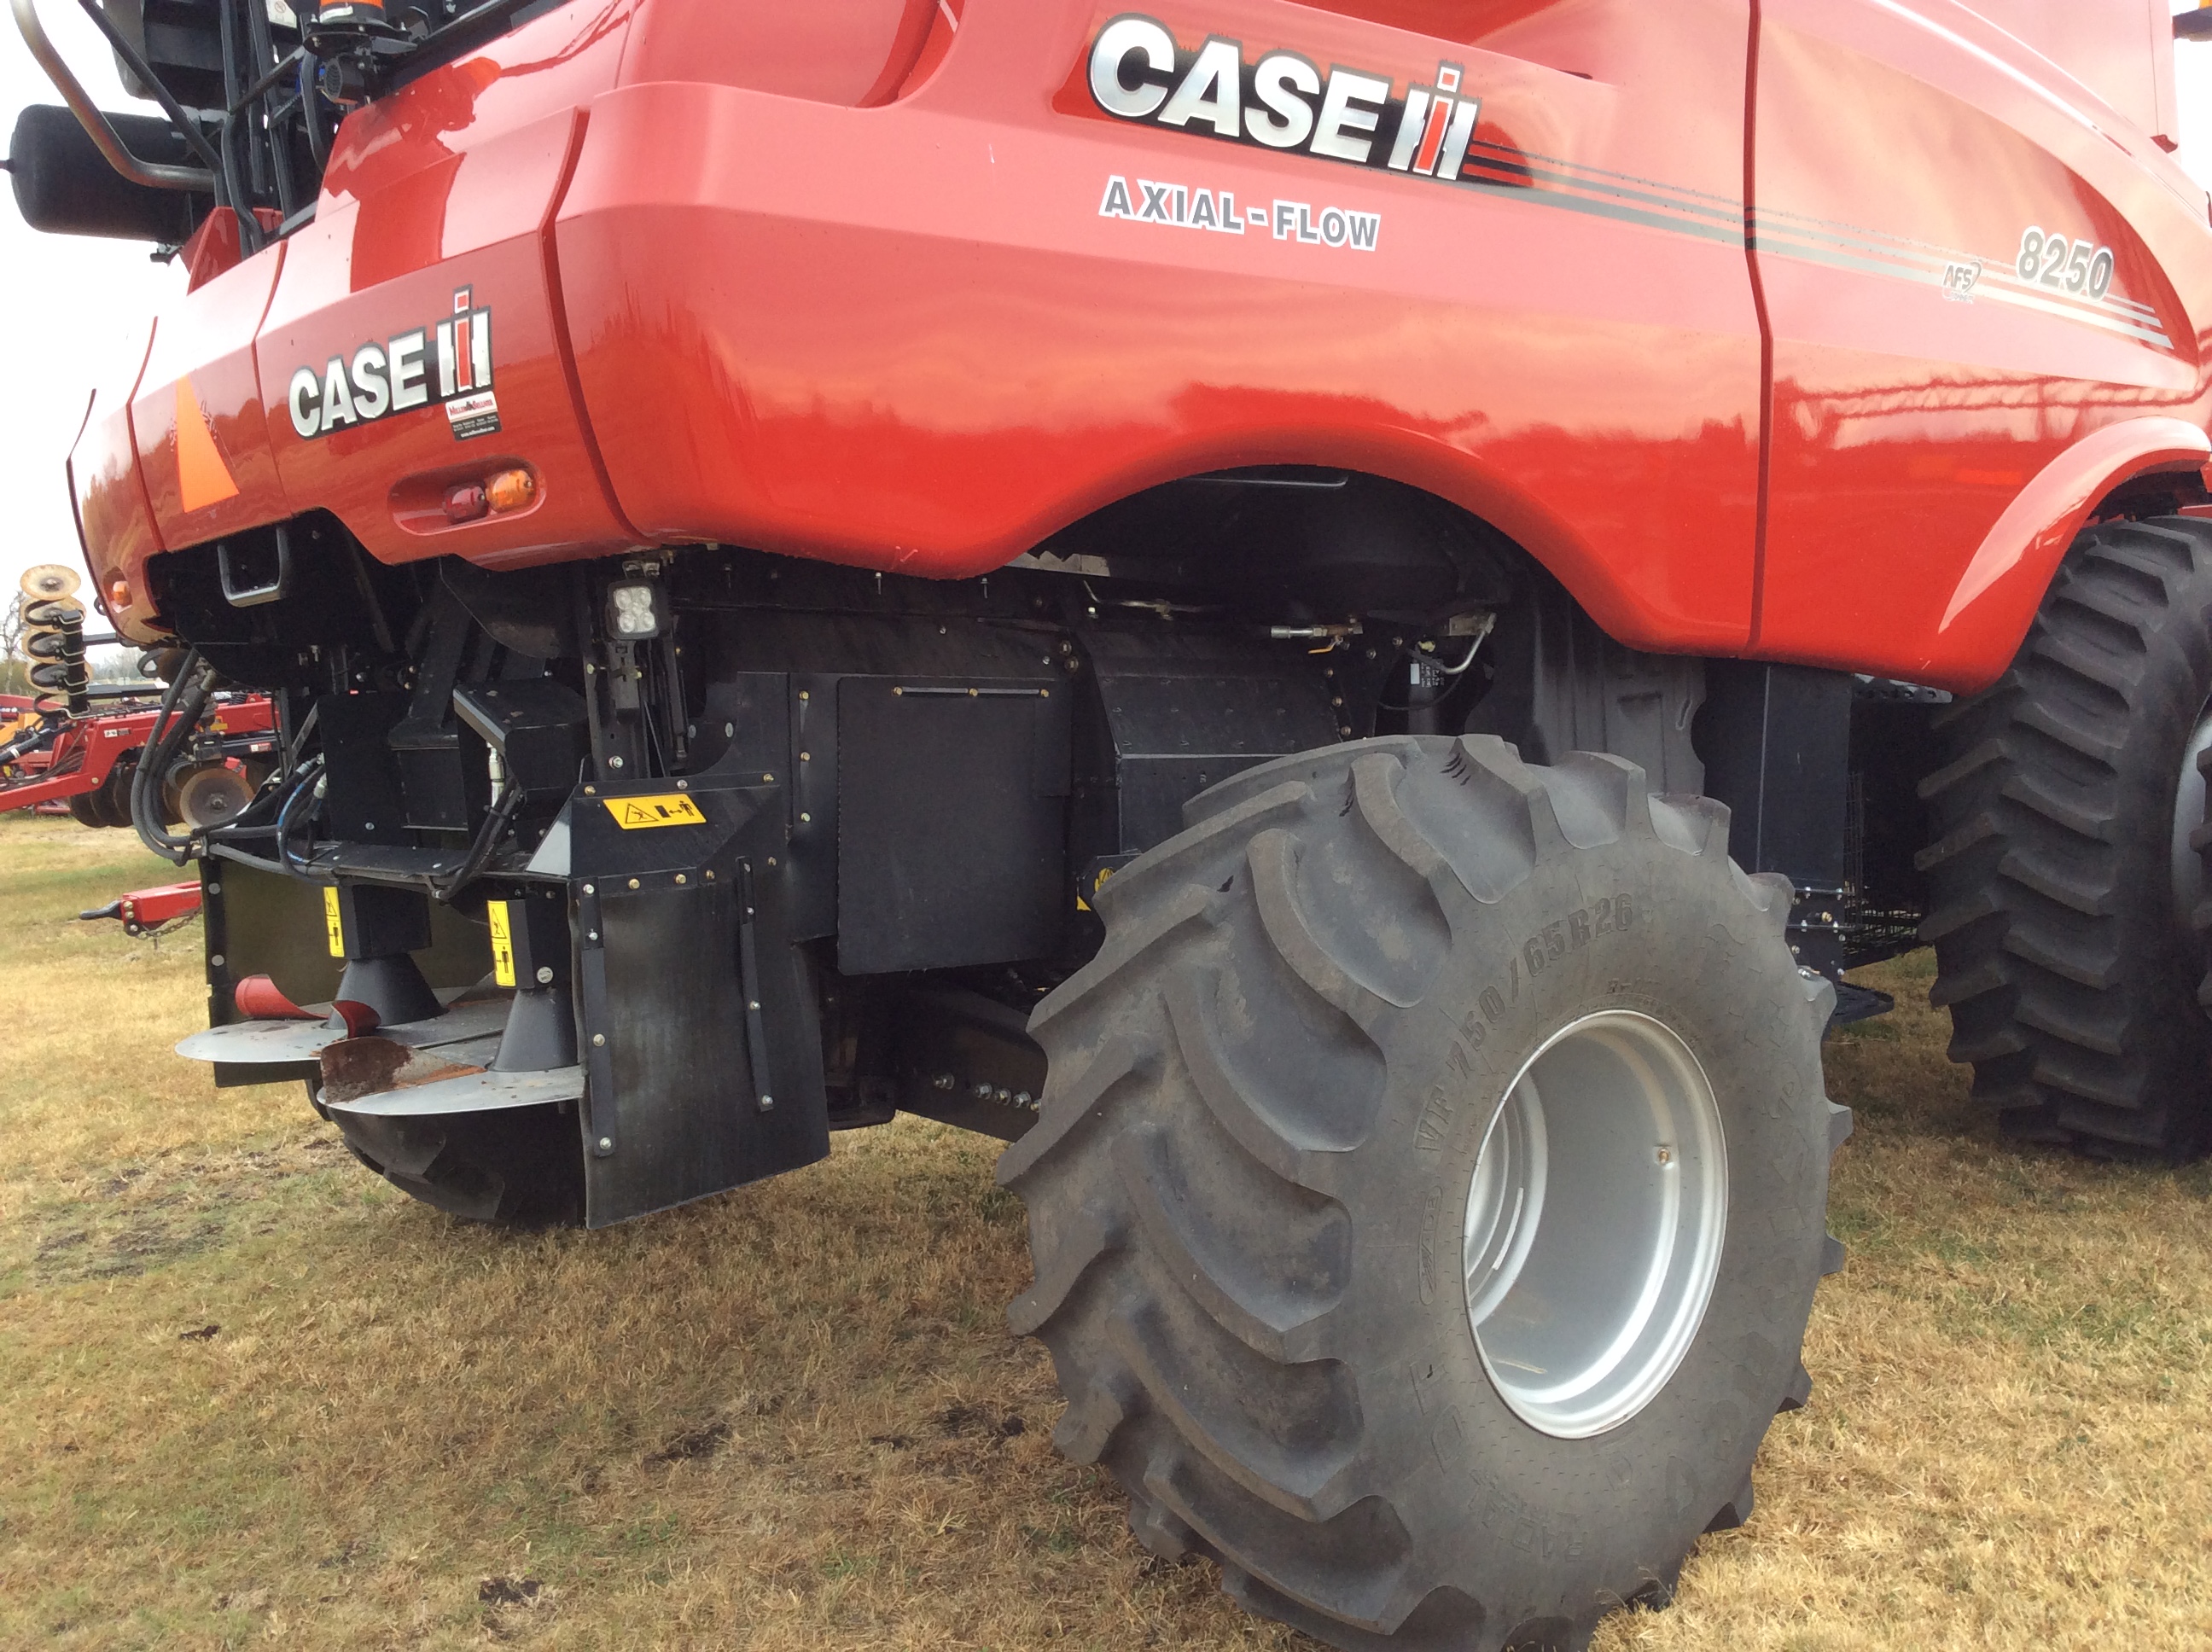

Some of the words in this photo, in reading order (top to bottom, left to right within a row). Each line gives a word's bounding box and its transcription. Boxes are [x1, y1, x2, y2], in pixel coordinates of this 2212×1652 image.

[1091, 19, 1388, 163] CASE
[1942, 265, 1973, 290] AFS
[2017, 226, 2114, 300] 8250
[288, 329, 428, 437] CASE
